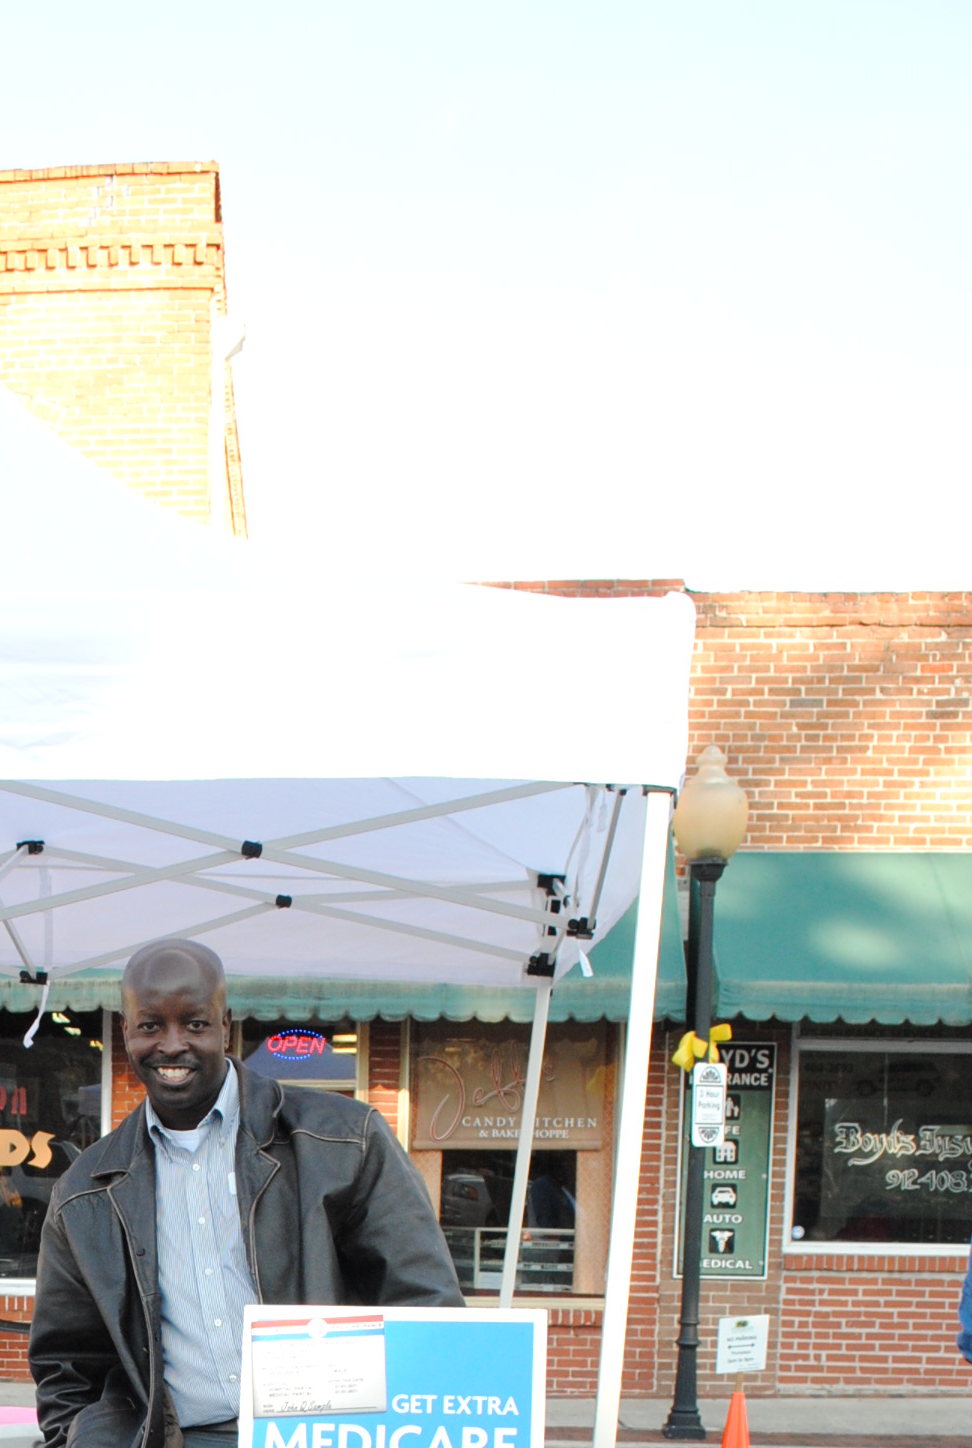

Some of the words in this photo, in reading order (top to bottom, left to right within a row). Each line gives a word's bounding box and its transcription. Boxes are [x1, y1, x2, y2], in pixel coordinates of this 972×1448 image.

[266, 1035, 326, 1056] OPEN
[720, 1048, 770, 1069] YD'S
[688, 1072, 769, 1086] IRANCE
[698, 1101, 720, 1112] Parking
[462, 1116, 516, 1128] CANDY
[535, 1116, 598, 1128] ITCHEN
[478, 1129, 489, 1139] &
[533, 1129, 569, 1139] HOPPE
[703, 1169, 747, 1180] HOME
[703, 1213, 743, 1224] AUTO
[699, 1258, 753, 1269] EDICAL
[391, 1394, 437, 1414] GET
[443, 1395, 520, 1416] EXTRA
